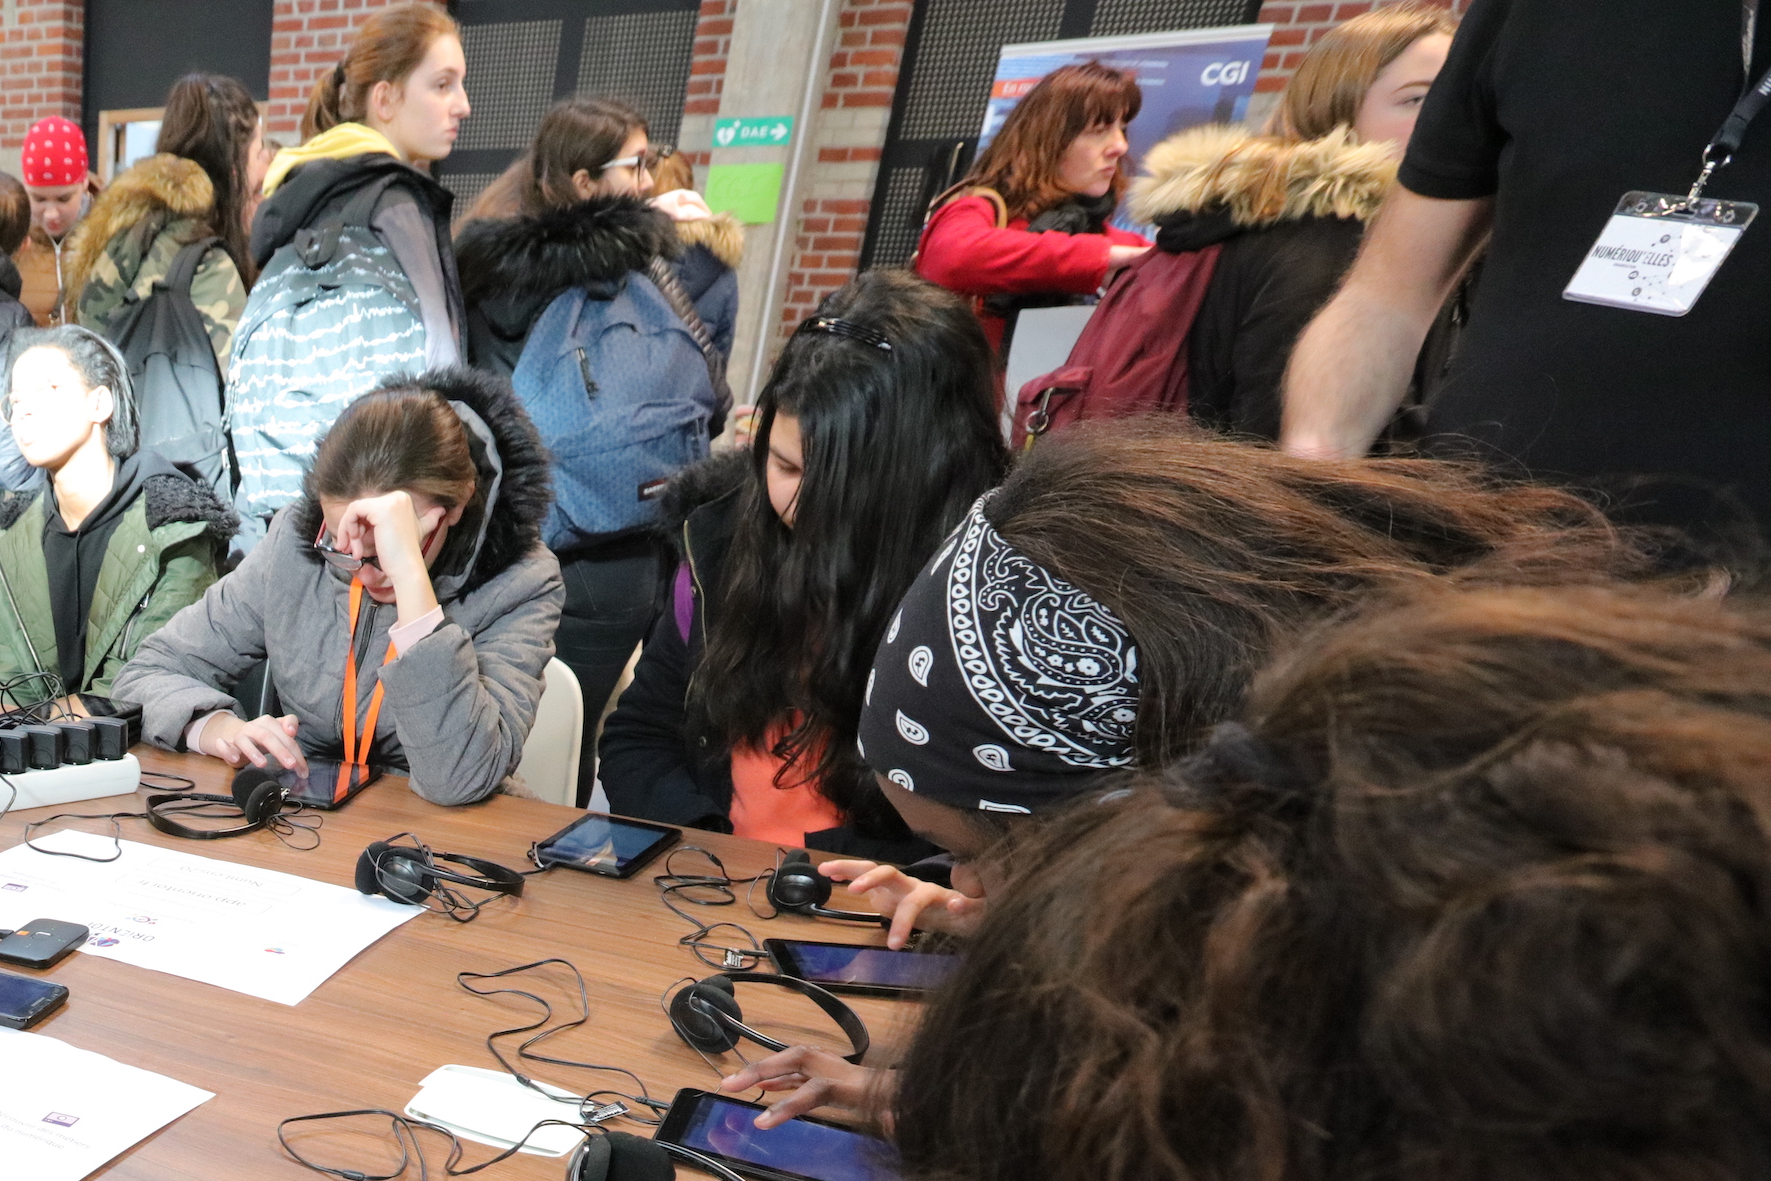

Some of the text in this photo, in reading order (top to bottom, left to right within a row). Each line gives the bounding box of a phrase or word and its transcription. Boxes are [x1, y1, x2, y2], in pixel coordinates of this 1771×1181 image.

[1200, 60, 1251, 87] CGI
[739, 125, 769, 139] DAE
[0, 1123, 65, 1150] du numérique
[37, 1126, 54, 1136] des
[56, 1132, 92, 1150] métiers
